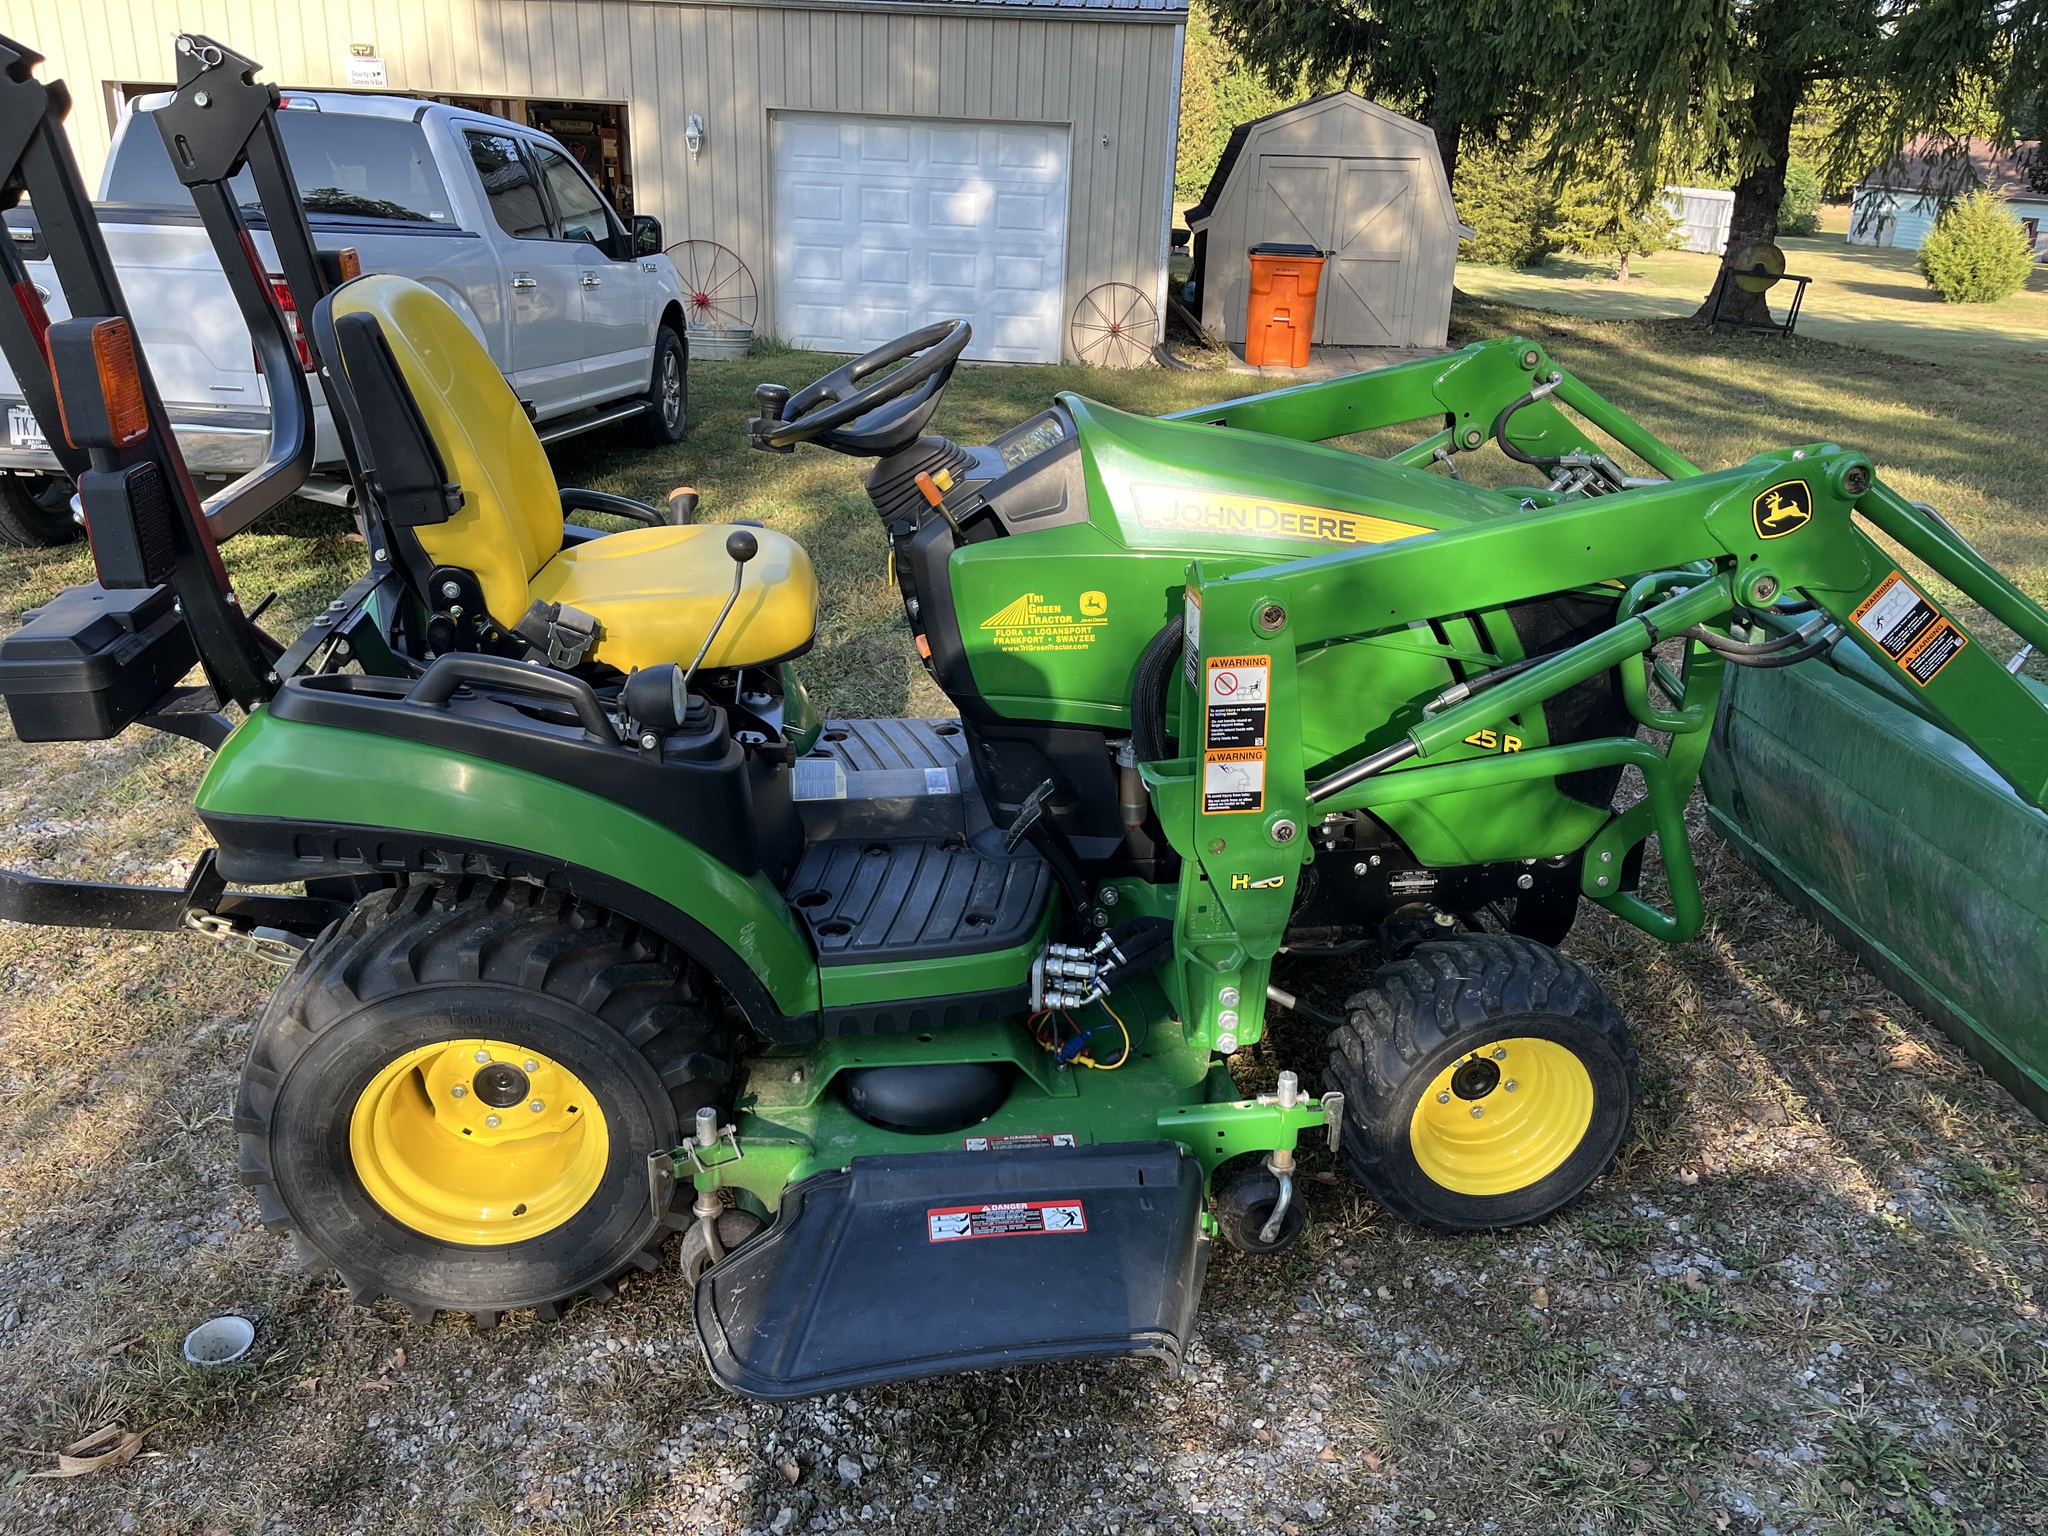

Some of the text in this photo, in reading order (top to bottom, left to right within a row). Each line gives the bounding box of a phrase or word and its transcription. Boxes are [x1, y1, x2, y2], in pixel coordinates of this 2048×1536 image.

[1162, 499, 1357, 540] JOHN DEERE
[1028, 593, 1044, 604] TRI
[1862, 577, 1895, 610] WARNING
[1028, 604, 1061, 614] GREEN
[1028, 614, 1073, 625] TRACTOR
[995, 626, 1093, 637] FLORA LOGANSPORT
[993, 634, 1096, 645] FRANKFORT SWAYZEE
[1912, 624, 1944, 655] WARNING
[1001, 643, 1089, 652] www.TriGreenTractor.com
[1220, 657, 1267, 668] WARNING
[1216, 751, 1263, 762] WARNING
[991, 1202, 1028, 1211] DANGER
